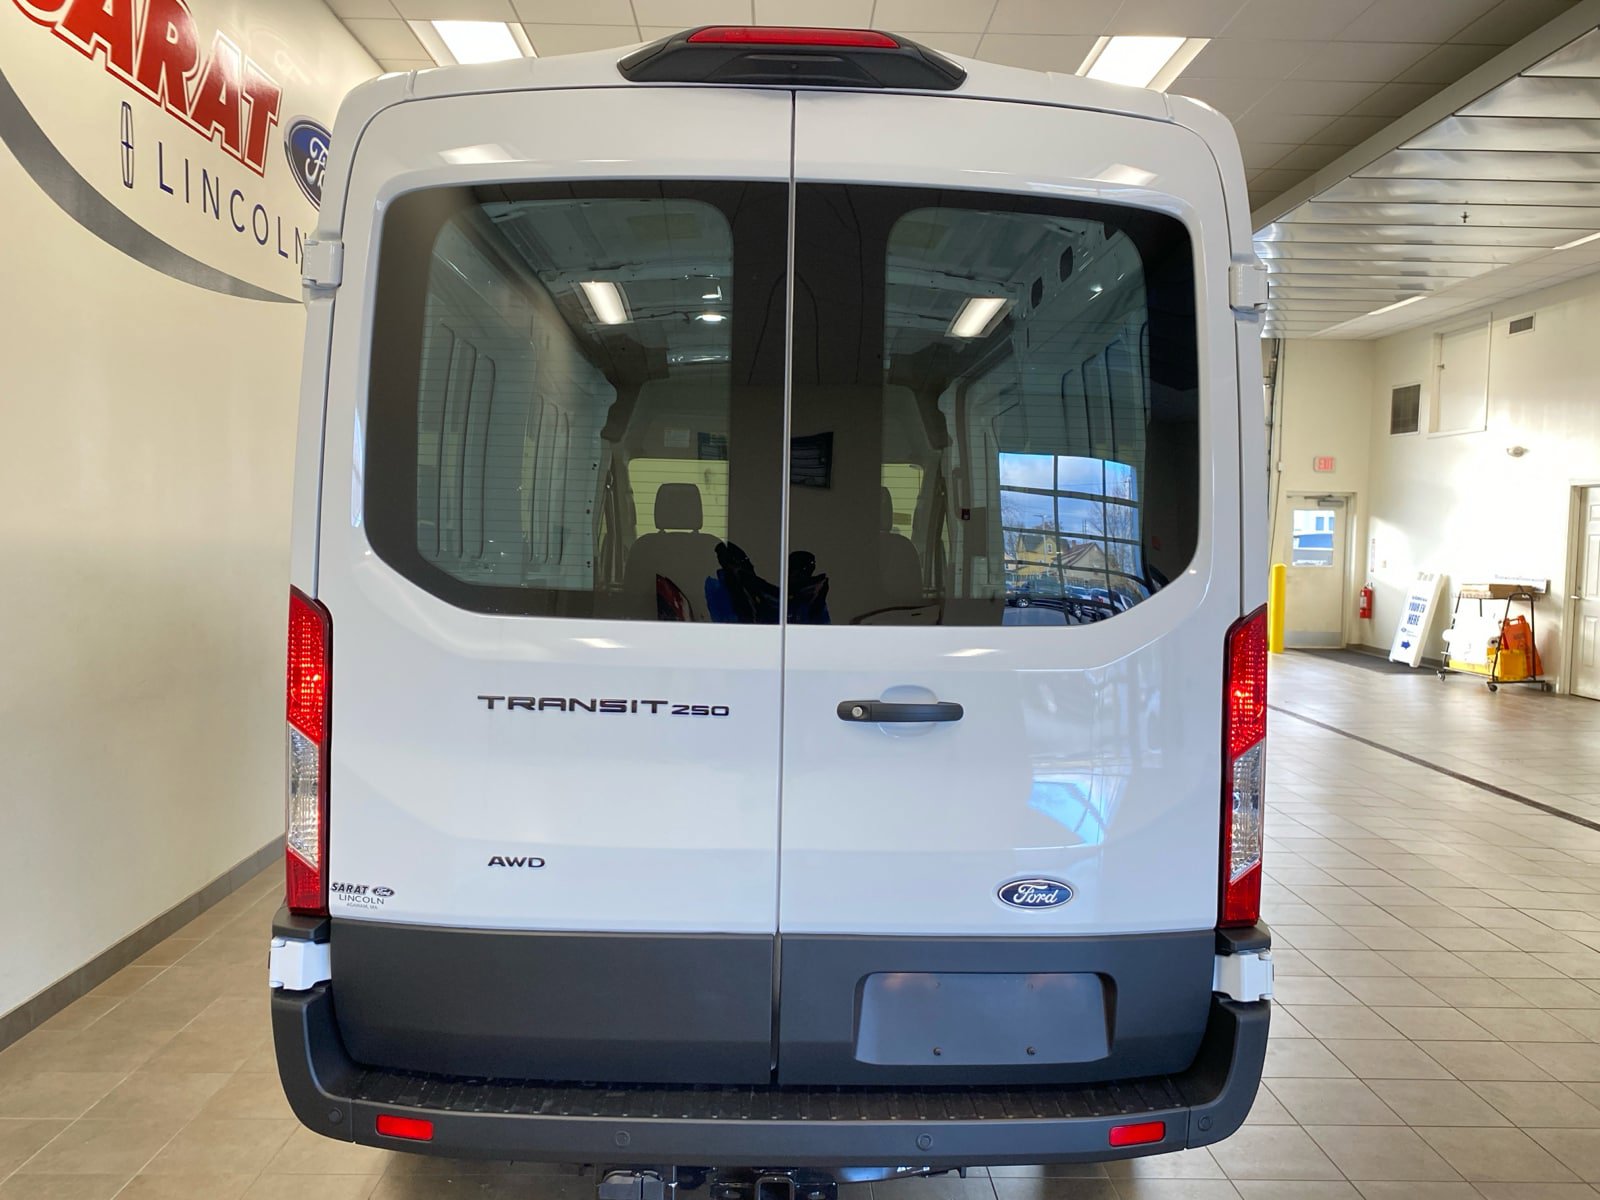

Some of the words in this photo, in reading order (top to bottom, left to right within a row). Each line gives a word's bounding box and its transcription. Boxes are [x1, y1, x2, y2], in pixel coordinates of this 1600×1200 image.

[12, 0, 284, 178] ARAT
[158, 141, 307, 275] LINCOLN
[477, 695, 668, 714] TRANSIT
[671, 705, 730, 716] 250
[488, 856, 546, 868] AWD
[331, 883, 369, 894] SARAT
[1013, 884, 1059, 904] Ford
[338, 894, 385, 905] LINCOLN
